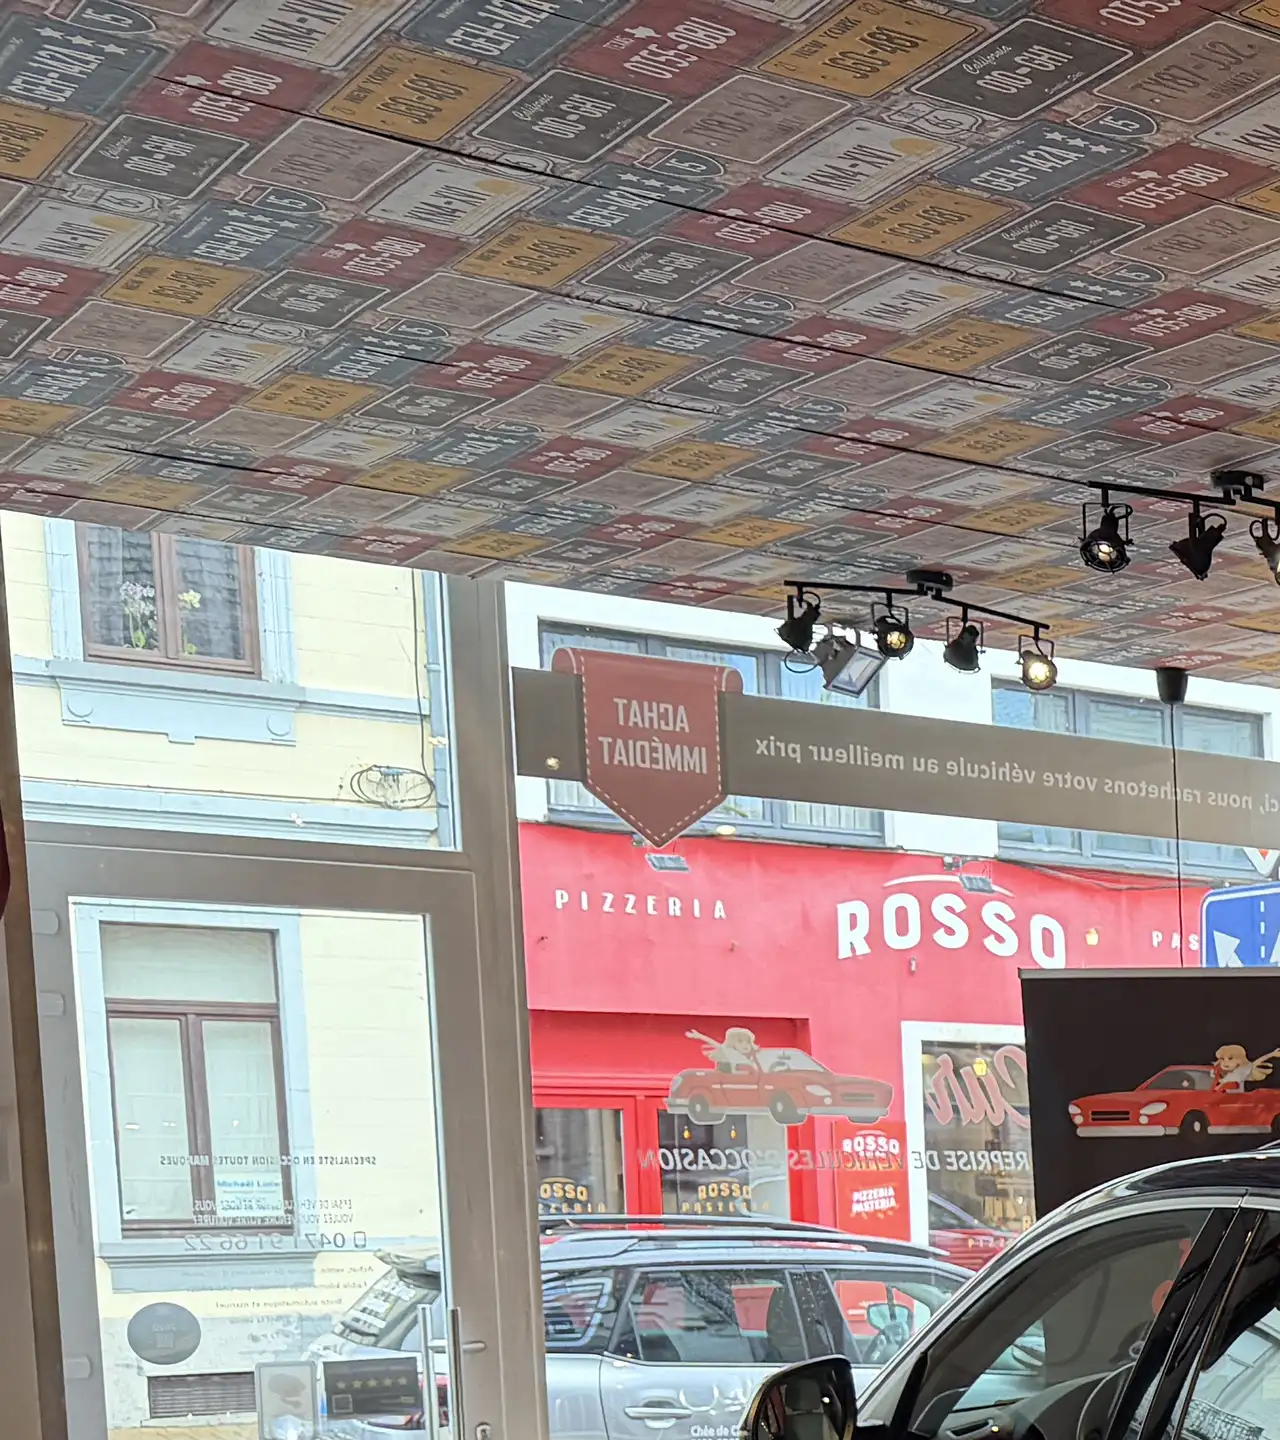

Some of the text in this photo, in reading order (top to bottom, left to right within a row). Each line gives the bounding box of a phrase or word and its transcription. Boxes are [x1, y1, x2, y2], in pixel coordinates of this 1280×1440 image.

[1109, 115, 1138, 134] 15
[554, 888, 727, 920] PIZZERIA
[837, 890, 1067, 970] ROSSO
[842, 1134, 901, 1154] ROSSO
[697, 1181, 753, 1201] ROSSO
